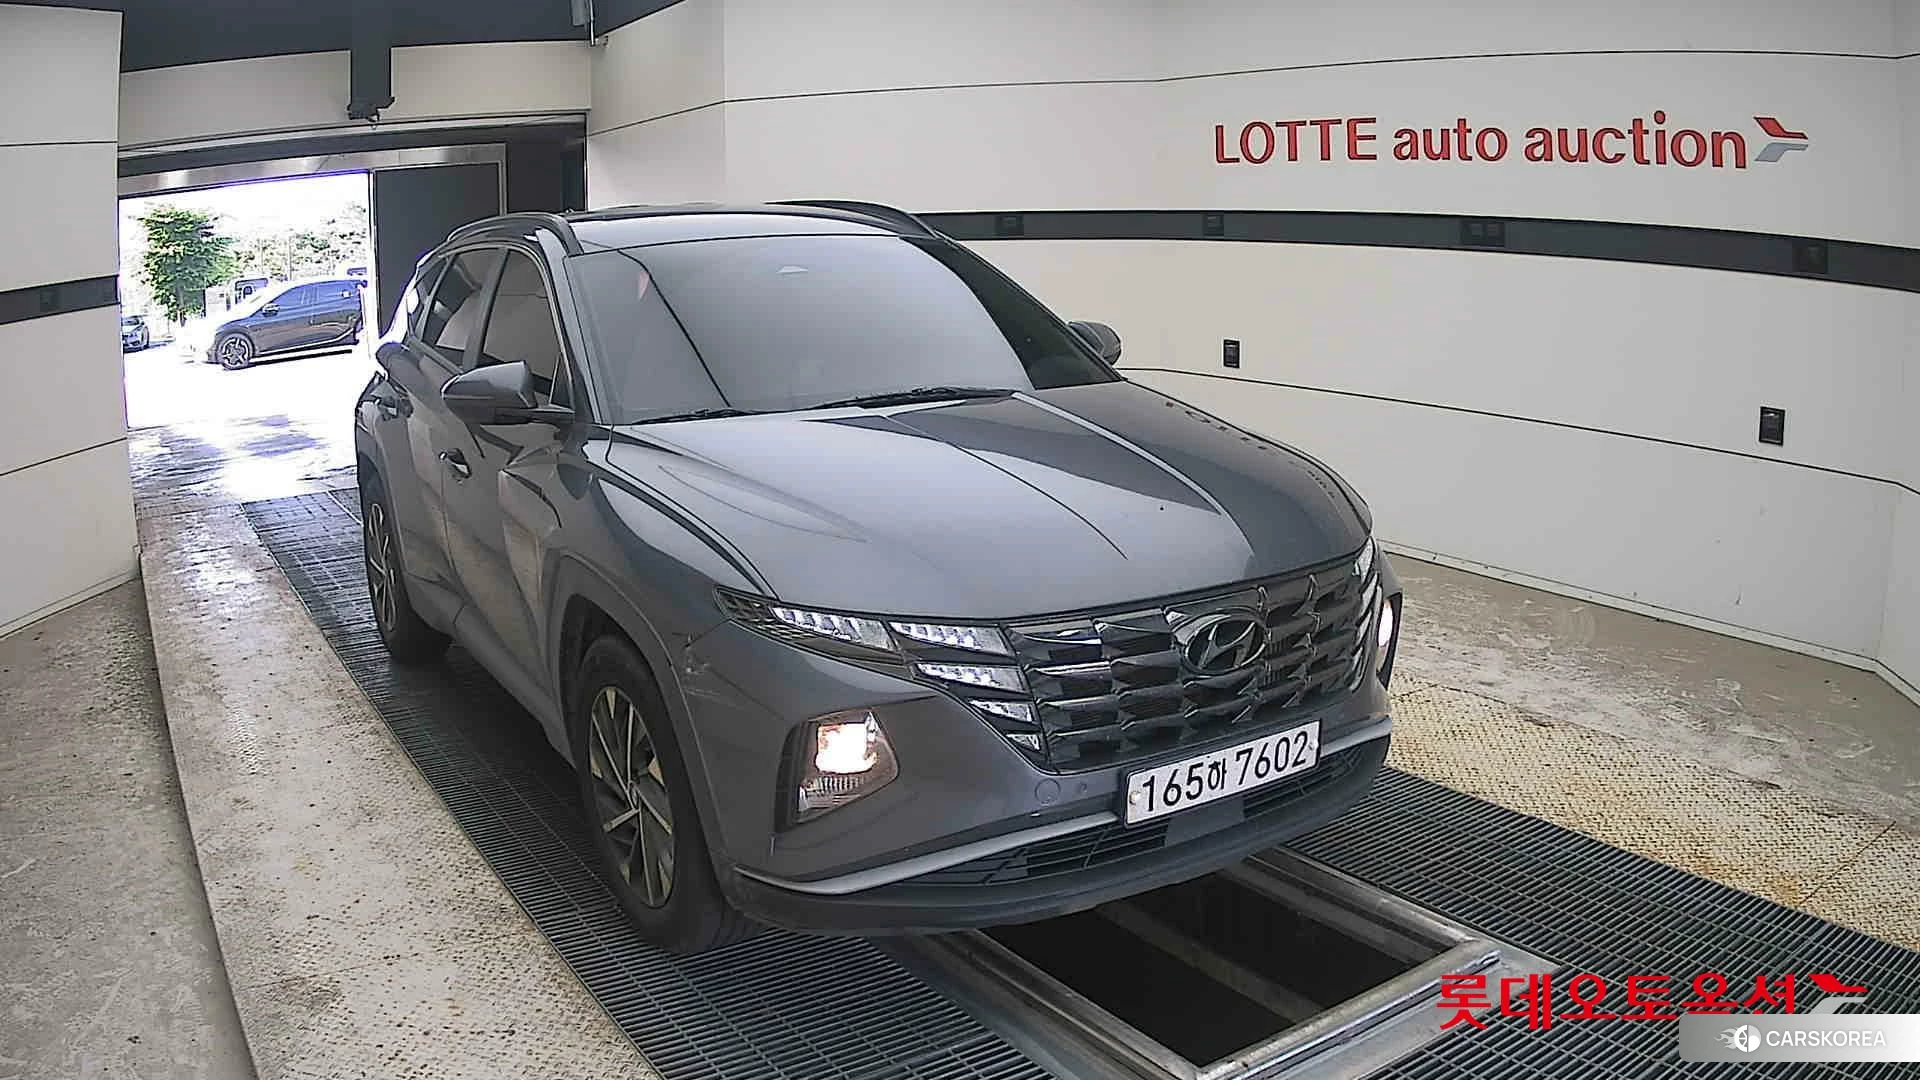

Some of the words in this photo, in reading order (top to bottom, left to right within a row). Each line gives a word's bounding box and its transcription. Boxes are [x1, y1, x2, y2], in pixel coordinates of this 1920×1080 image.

[1215, 117, 1378, 165] LOTTE
[1392, 116, 1510, 162] auto
[1523, 111, 1748, 170] auction
